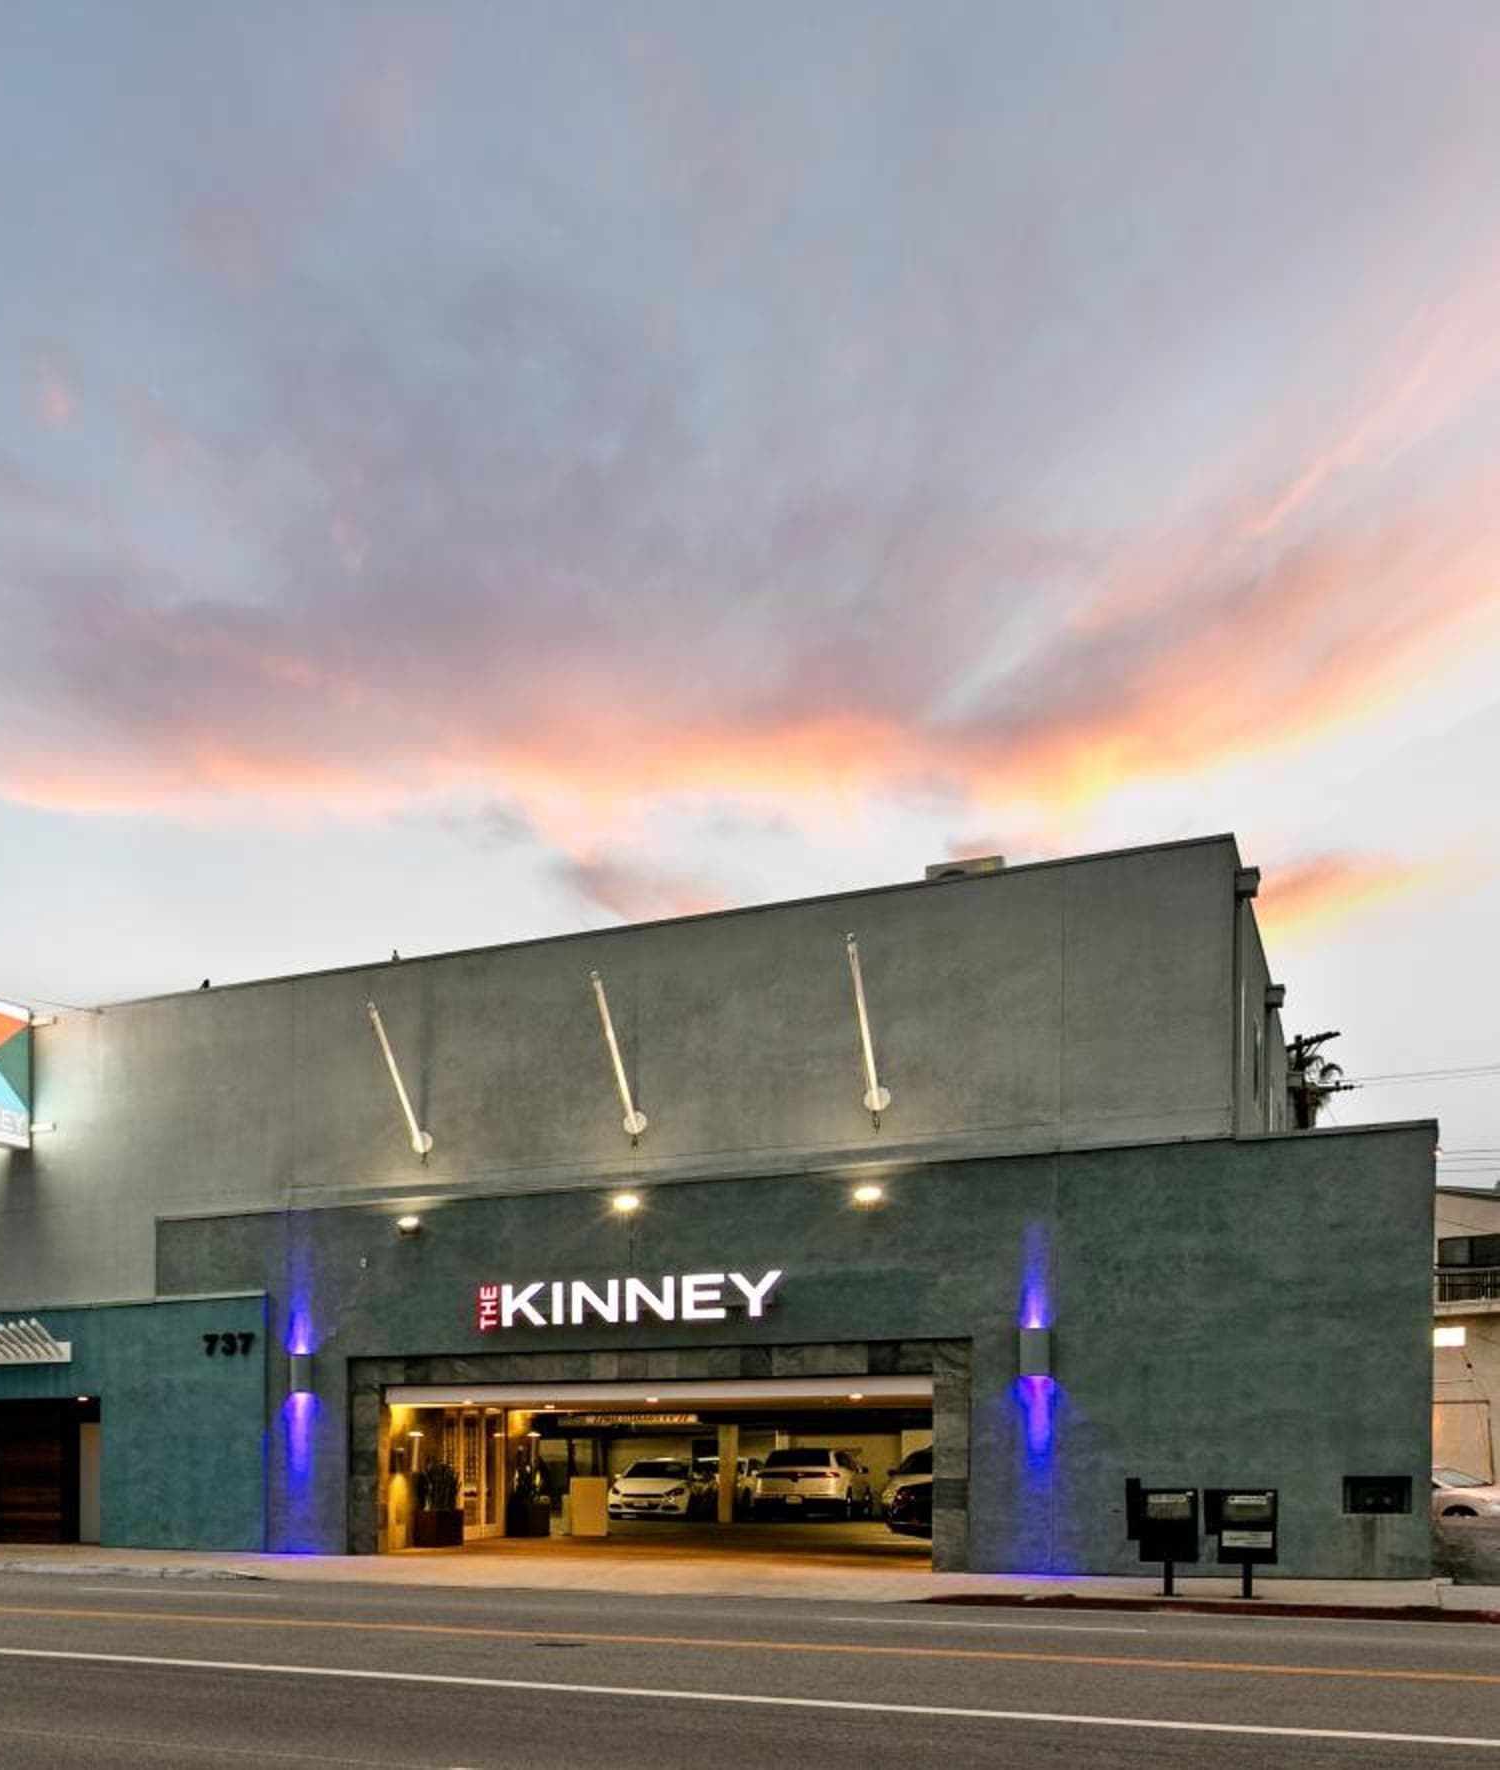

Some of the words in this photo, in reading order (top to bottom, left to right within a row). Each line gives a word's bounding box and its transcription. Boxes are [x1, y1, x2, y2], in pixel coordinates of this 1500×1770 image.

[479, 1285, 498, 1330] THE
[501, 1269, 783, 1328] KINNEY
[203, 1332, 256, 1358] 737
